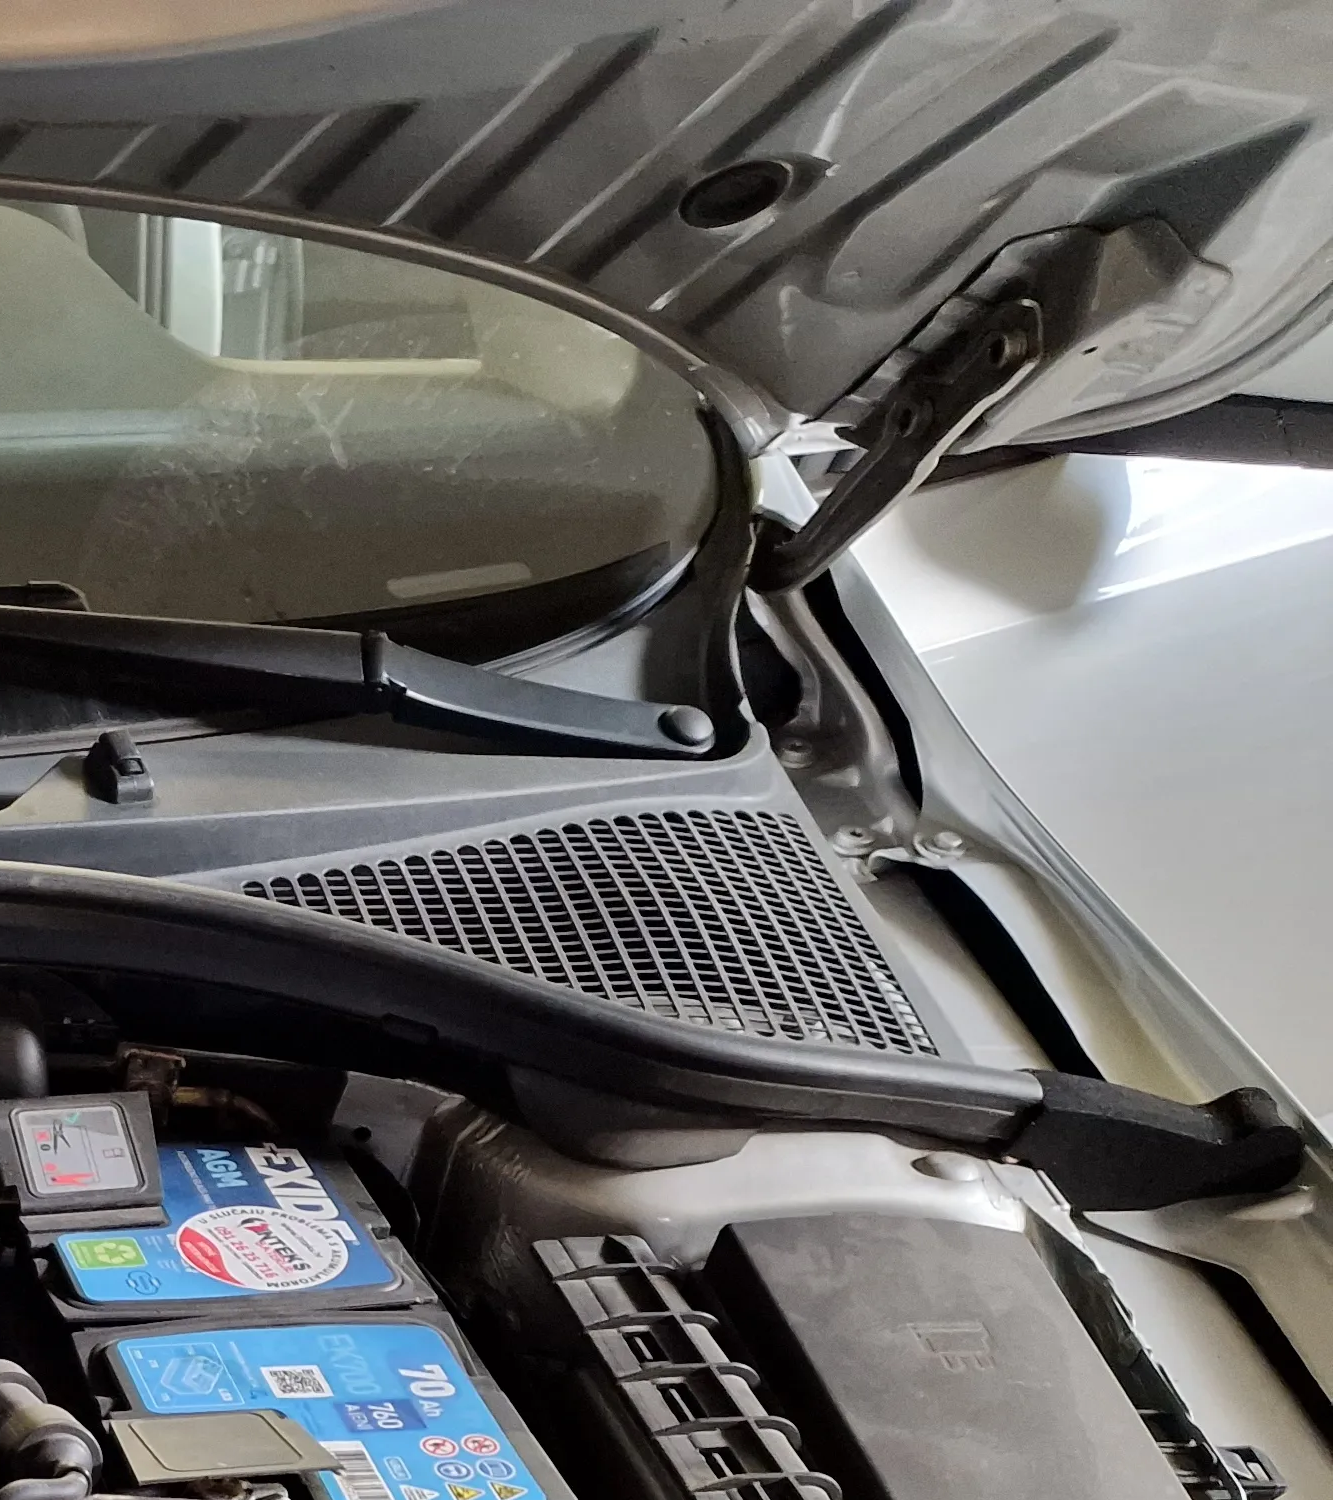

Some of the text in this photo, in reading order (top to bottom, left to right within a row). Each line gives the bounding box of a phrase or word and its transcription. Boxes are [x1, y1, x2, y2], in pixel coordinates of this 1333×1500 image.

[196, 1148, 249, 1188] AGM
[271, 1210, 334, 1240] PROBLEMA
[398, 1364, 456, 1417] 70 Ah
[345, 1403, 359, 1413] A
[367, 1401, 404, 1429] 760
